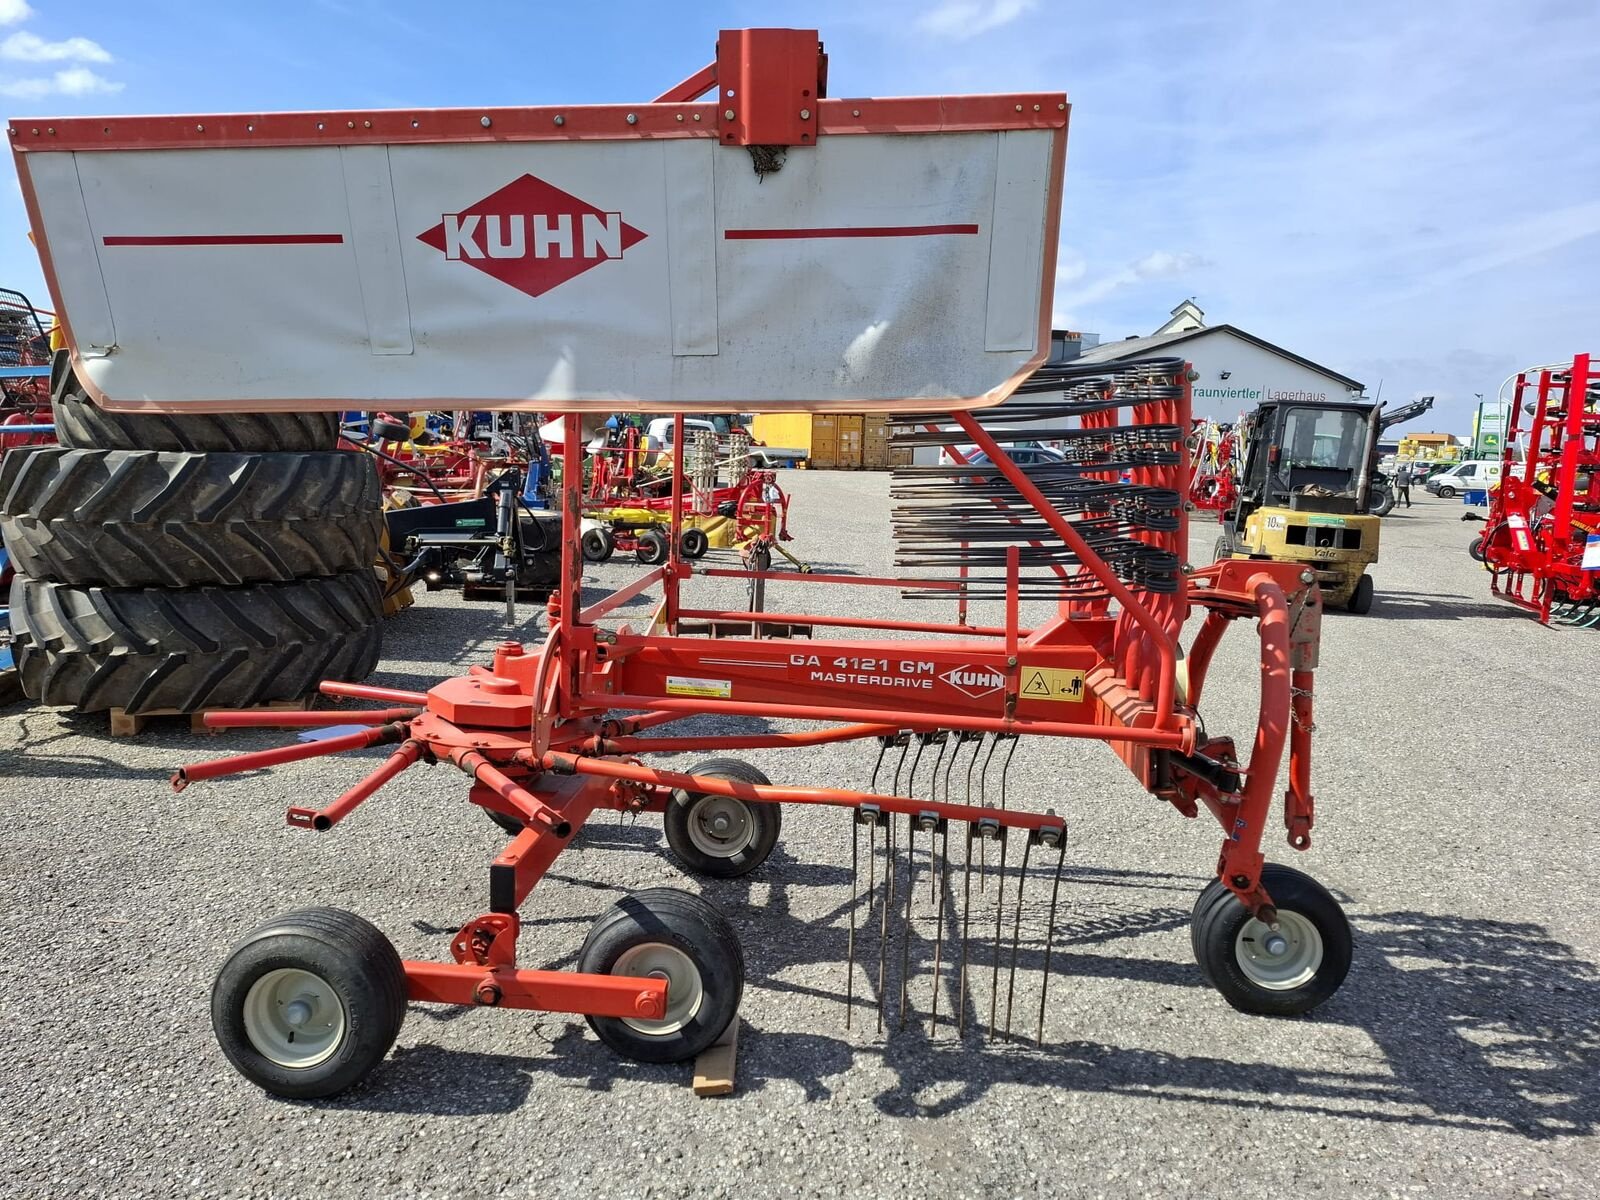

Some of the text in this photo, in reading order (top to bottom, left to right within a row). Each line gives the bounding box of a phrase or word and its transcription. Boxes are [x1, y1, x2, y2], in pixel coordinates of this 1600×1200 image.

[443, 213, 622, 260] KUHN
[1192, 387, 1326, 401] raunviertler Lagerhaus
[790, 654, 935, 674] GA 4121 GM
[810, 671, 933, 689] MASTERDRIVE
[949, 670, 1004, 688] KUHN
